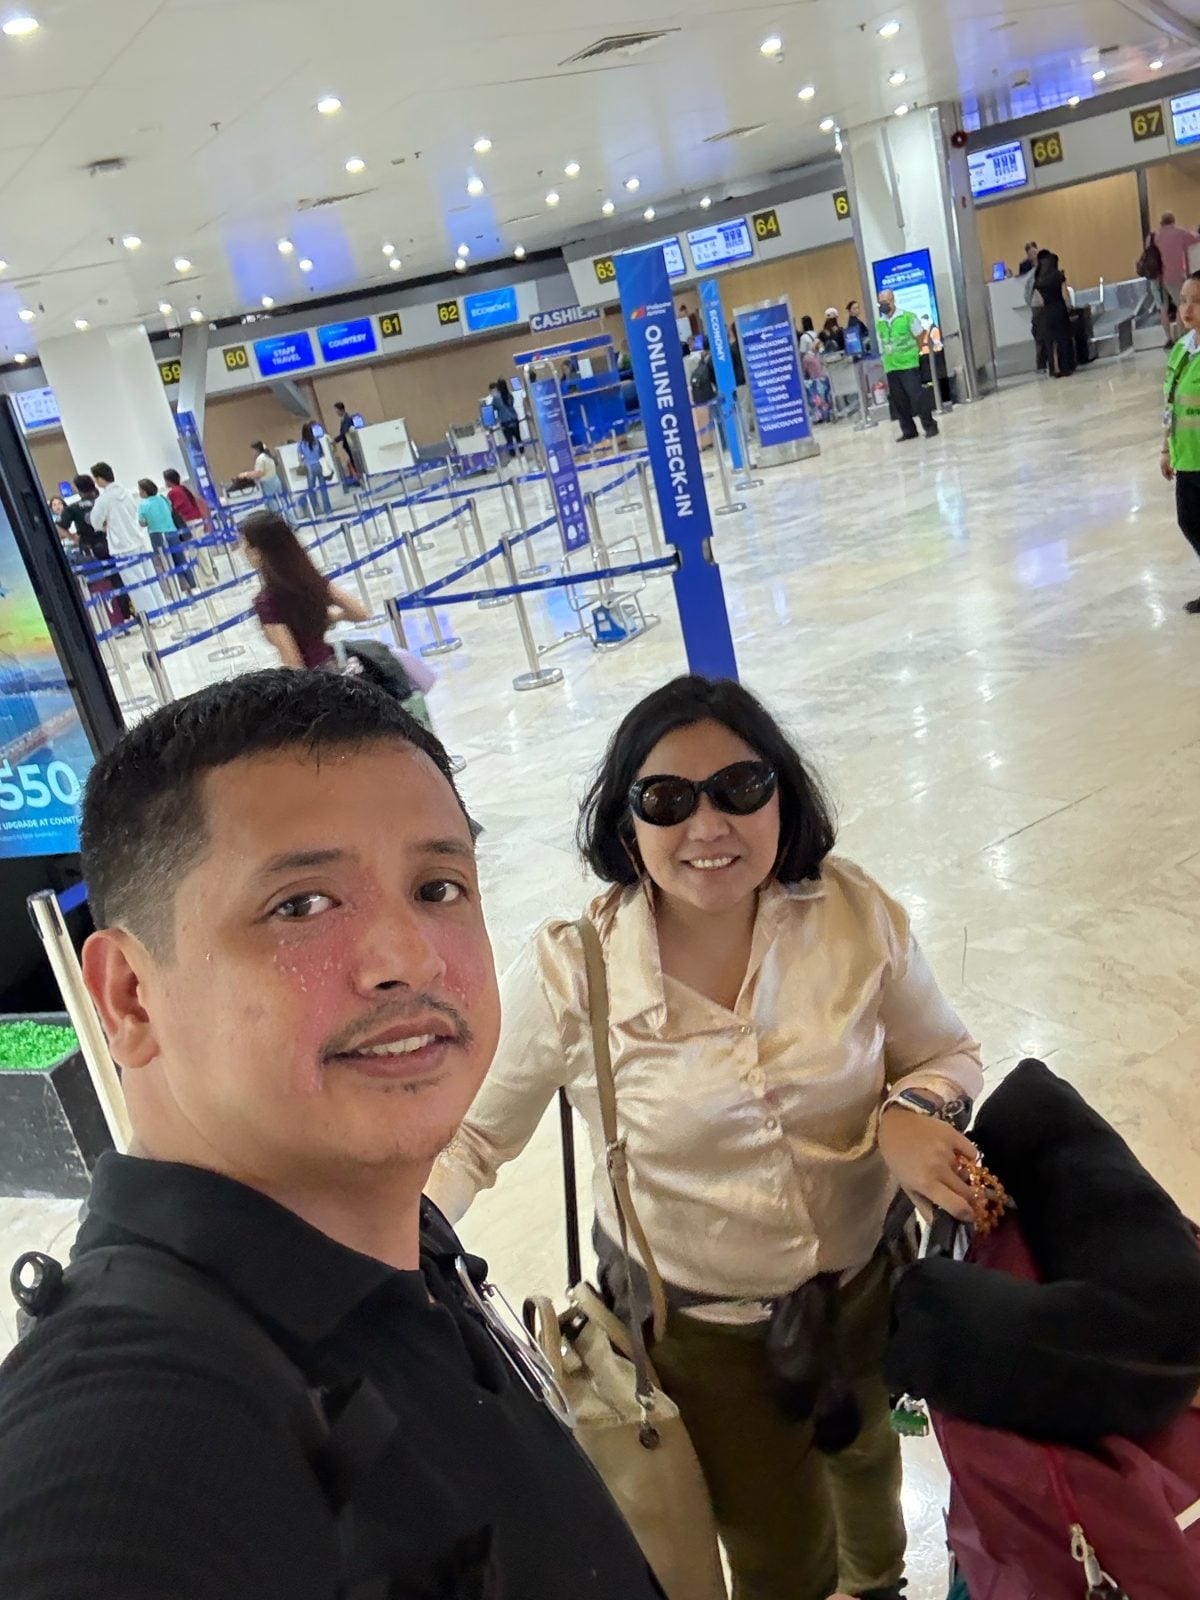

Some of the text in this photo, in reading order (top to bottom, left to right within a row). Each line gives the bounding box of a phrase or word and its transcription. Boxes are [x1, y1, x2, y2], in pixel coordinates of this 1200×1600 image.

[1134, 112, 1160, 135] 67
[1033, 139, 1060, 160] 66
[835, 196, 849, 215] 6
[755, 215, 778, 236] 64
[596, 261, 616, 279] 63
[440, 304, 458, 321] 62
[471, 302, 511, 318] ECONOMY
[382, 316, 401, 335] 61
[328, 333, 368, 349] COURTESY
[709, 309, 726, 362] ECONOMY
[226, 350, 247, 368] 60
[272, 353, 302, 366] TRAVEL
[273, 345, 297, 358] STAFF
[162, 364, 181, 382] 59
[645, 325, 694, 517] ONLINE CHECK-IN
[3, 819, 39, 830] UPGRADE
[40, 818, 49, 826] AT
